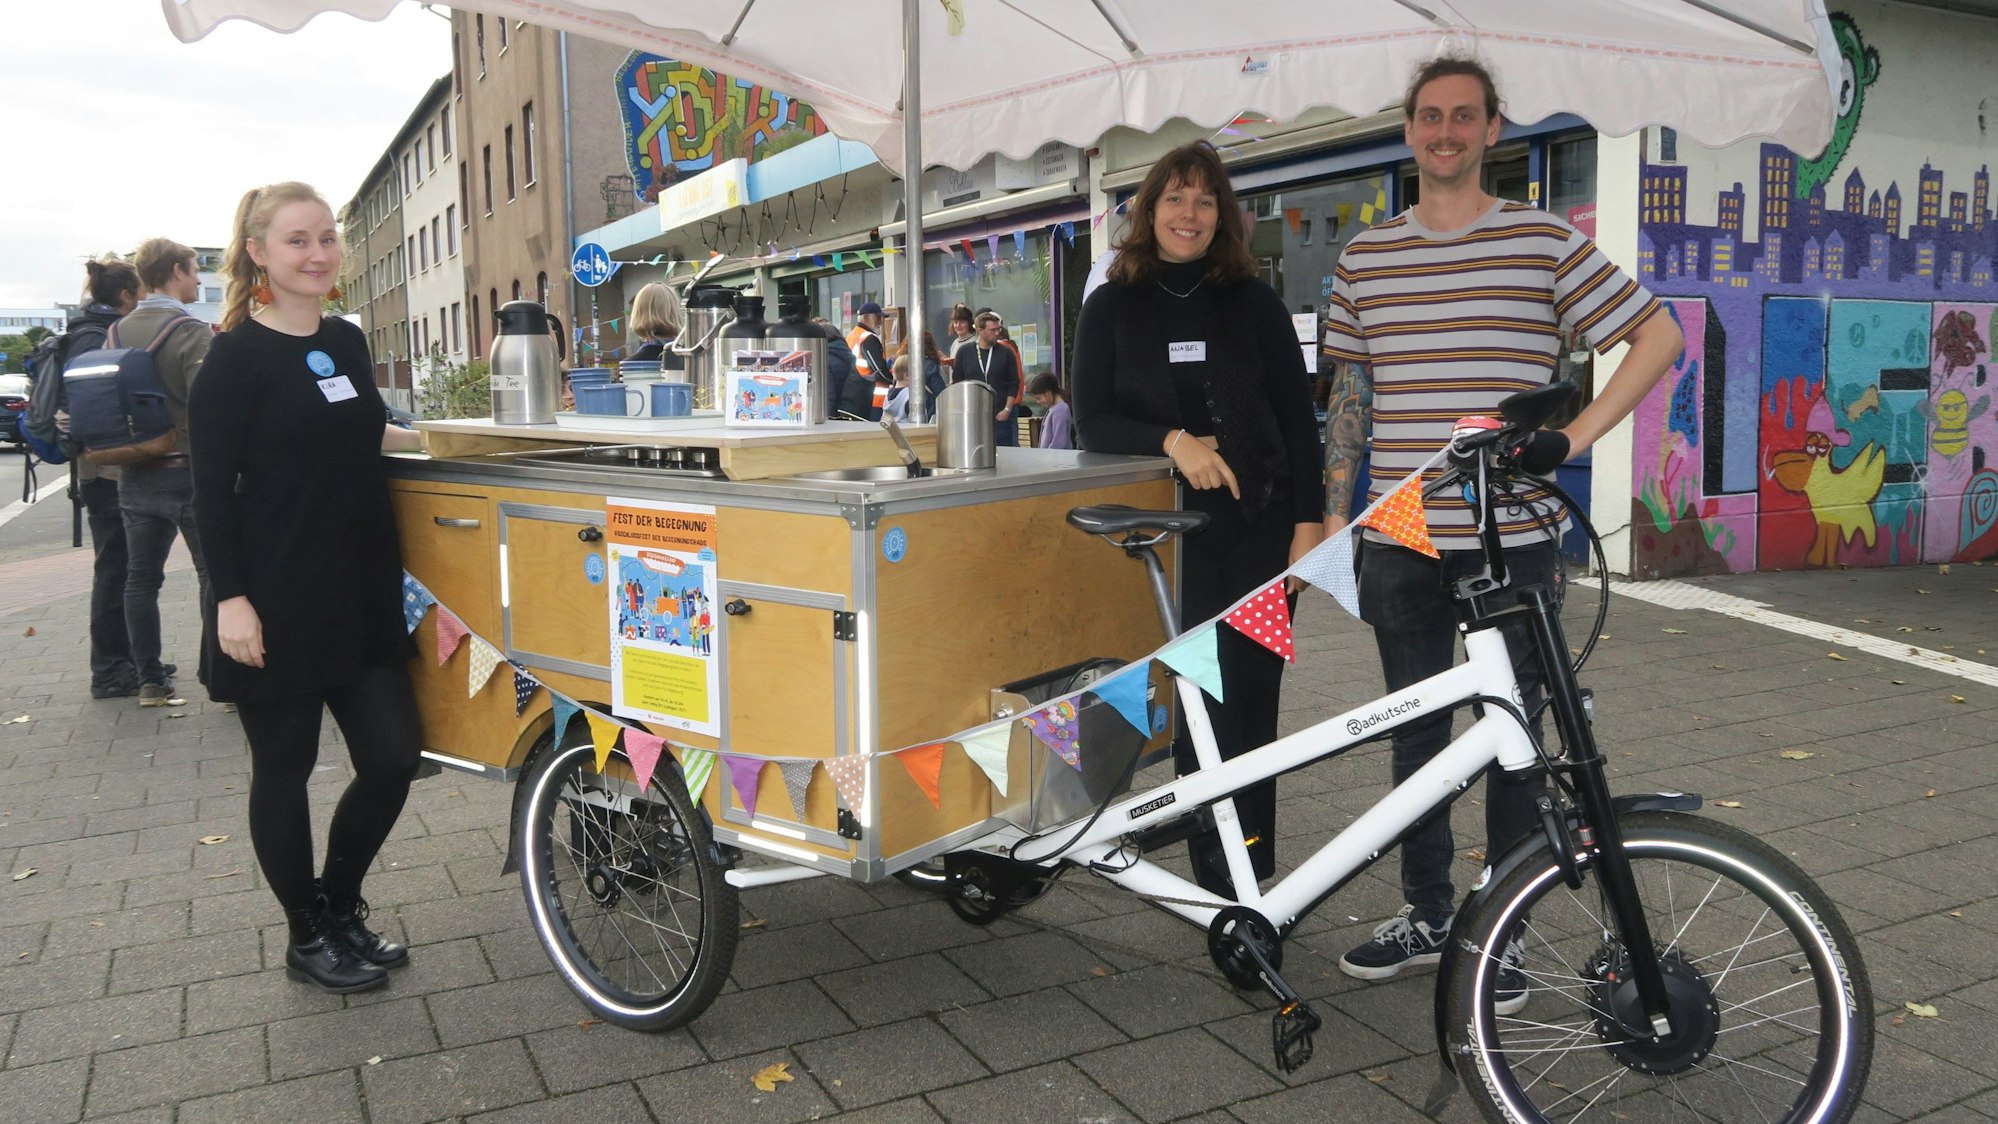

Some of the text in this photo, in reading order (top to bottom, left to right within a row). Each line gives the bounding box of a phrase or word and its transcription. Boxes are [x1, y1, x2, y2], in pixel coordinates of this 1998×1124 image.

[506, 376, 520, 388] Tee
[613, 513, 707, 532] FEST DER BEGEGNUNG
[1346, 698, 1421, 736] Radkutsche
[1132, 794, 1174, 818] MUSKETIER
[1788, 890, 1858, 1019] CONTINENTAL
[1466, 1016, 1519, 1124] ONTINENTAL
